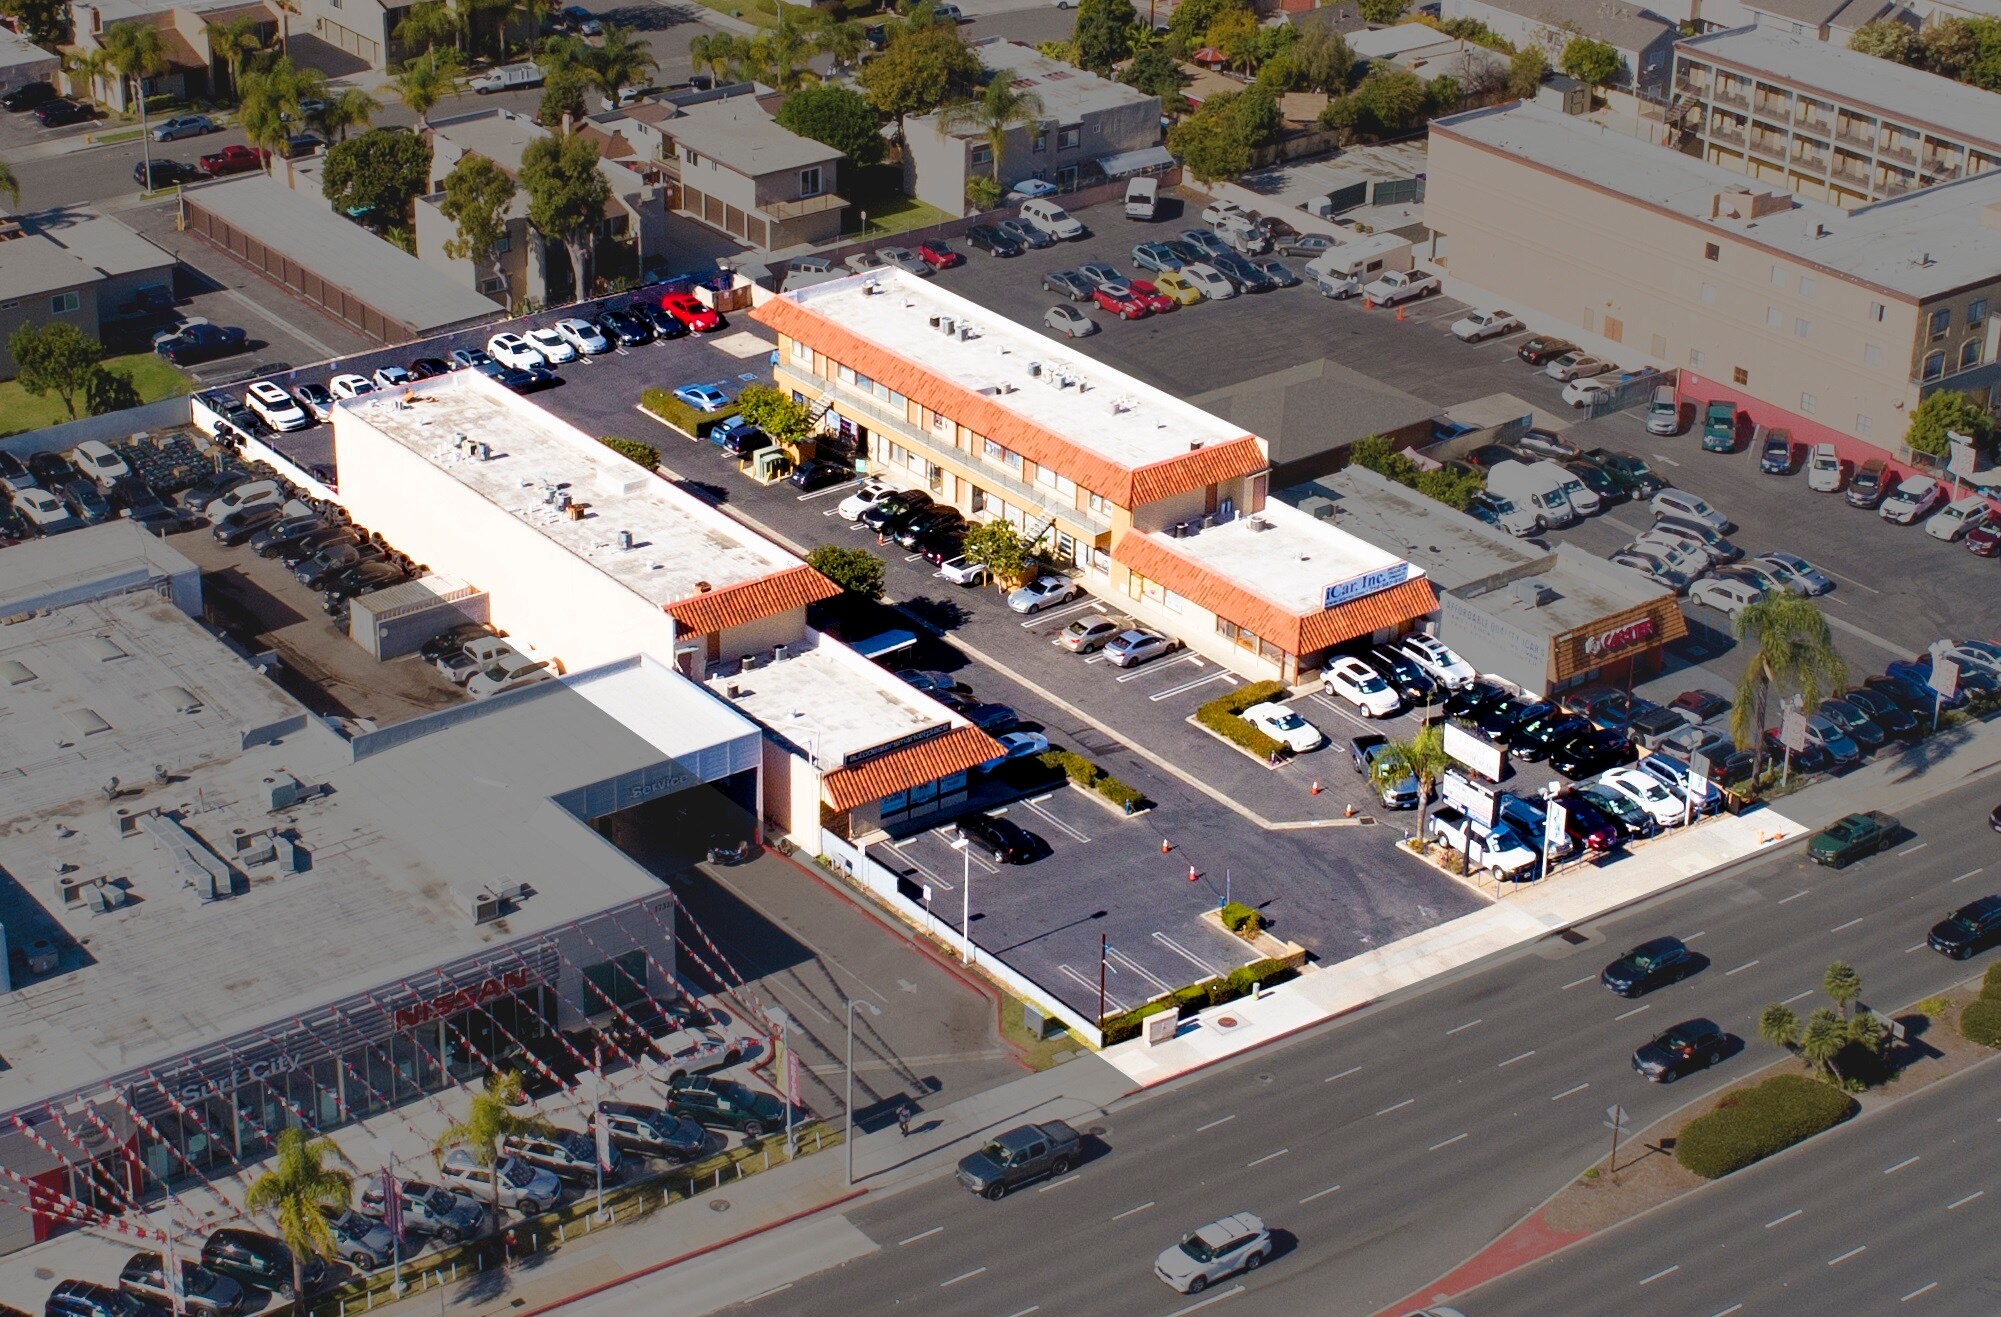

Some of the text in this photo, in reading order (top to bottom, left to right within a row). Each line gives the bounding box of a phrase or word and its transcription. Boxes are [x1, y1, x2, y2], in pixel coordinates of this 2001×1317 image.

[630, 775, 688, 798] Service
[394, 967, 527, 1031] NISSAN
[249, 1053, 301, 1082] City
